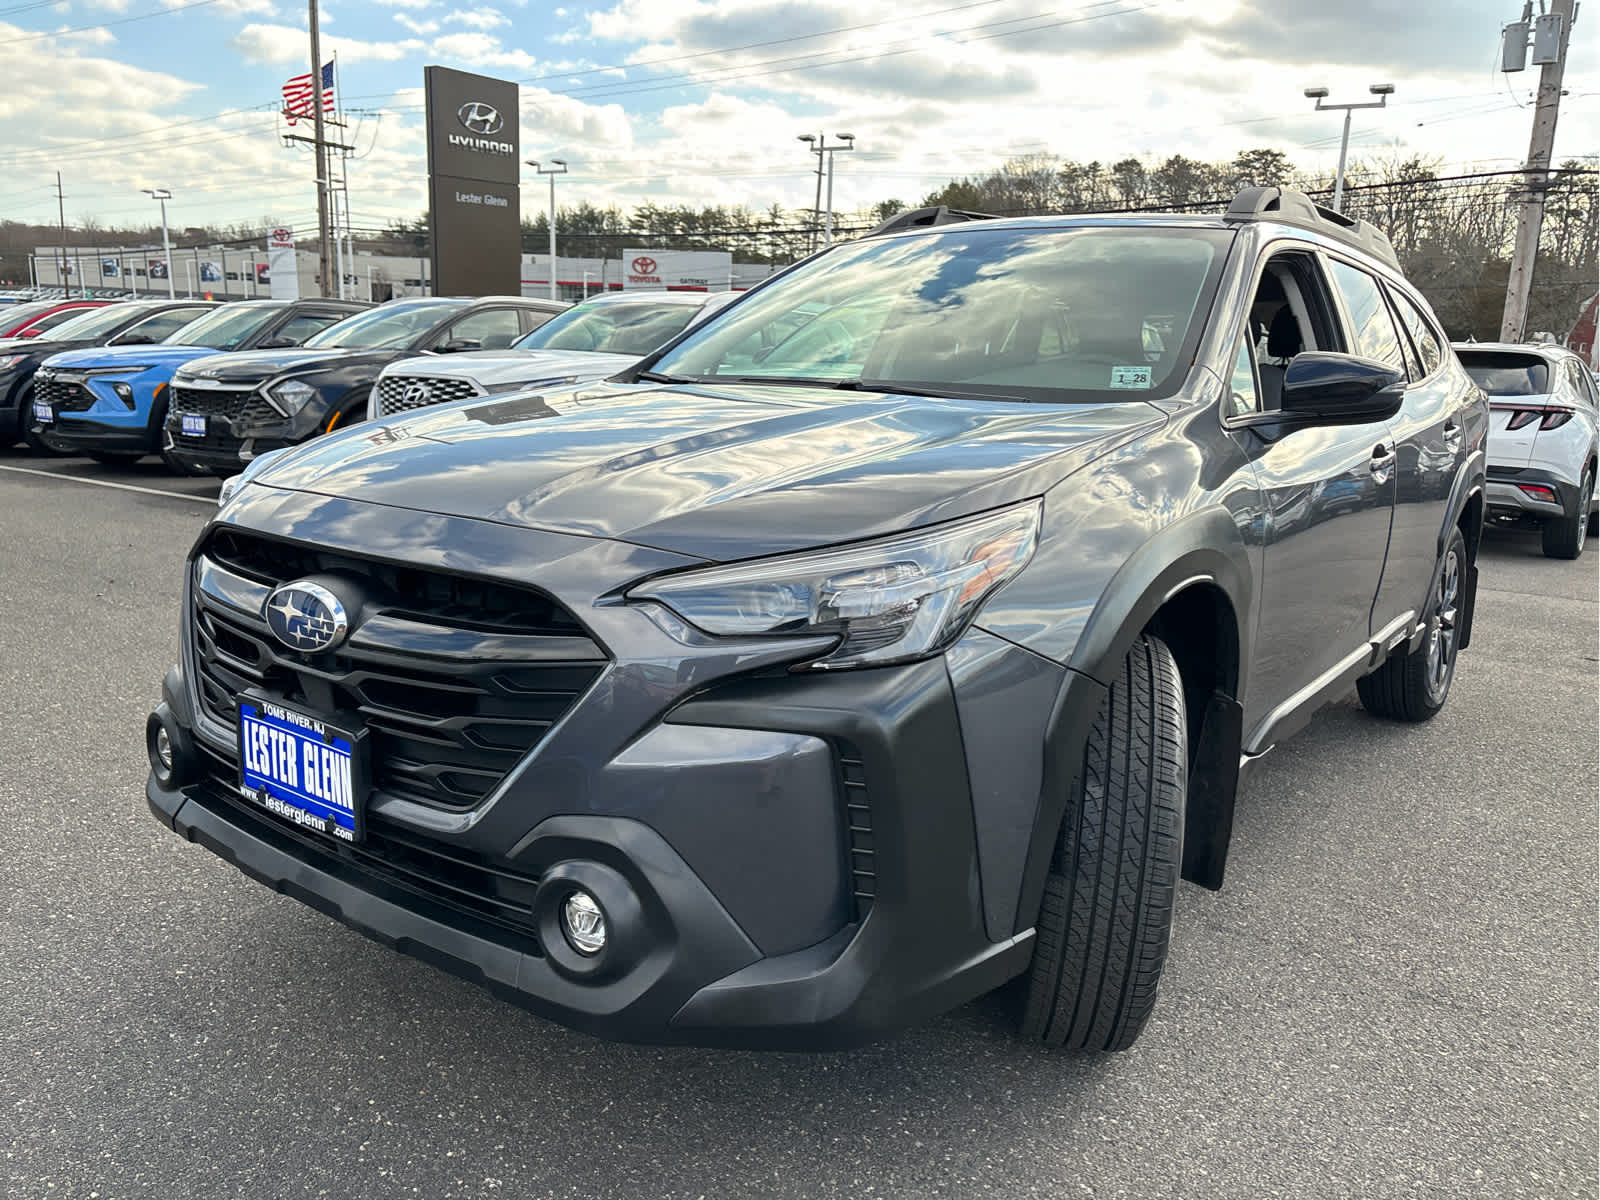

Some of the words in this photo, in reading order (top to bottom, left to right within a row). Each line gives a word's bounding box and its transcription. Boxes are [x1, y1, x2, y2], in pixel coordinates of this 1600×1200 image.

[449, 134, 513, 153] HYUNDAI
[456, 192, 482, 204] Lester
[484, 194, 508, 207] Glenn
[628, 275, 661, 284] TOYOTA
[1118, 374, 1125, 383] 1
[1134, 373, 1147, 383] 28
[262, 703, 285, 720] TOMS
[314, 723, 325, 735] NJ
[243, 719, 298, 788] LESTER
[303, 741, 354, 810] GLENN
[265, 793, 326, 832] lesterglenn
